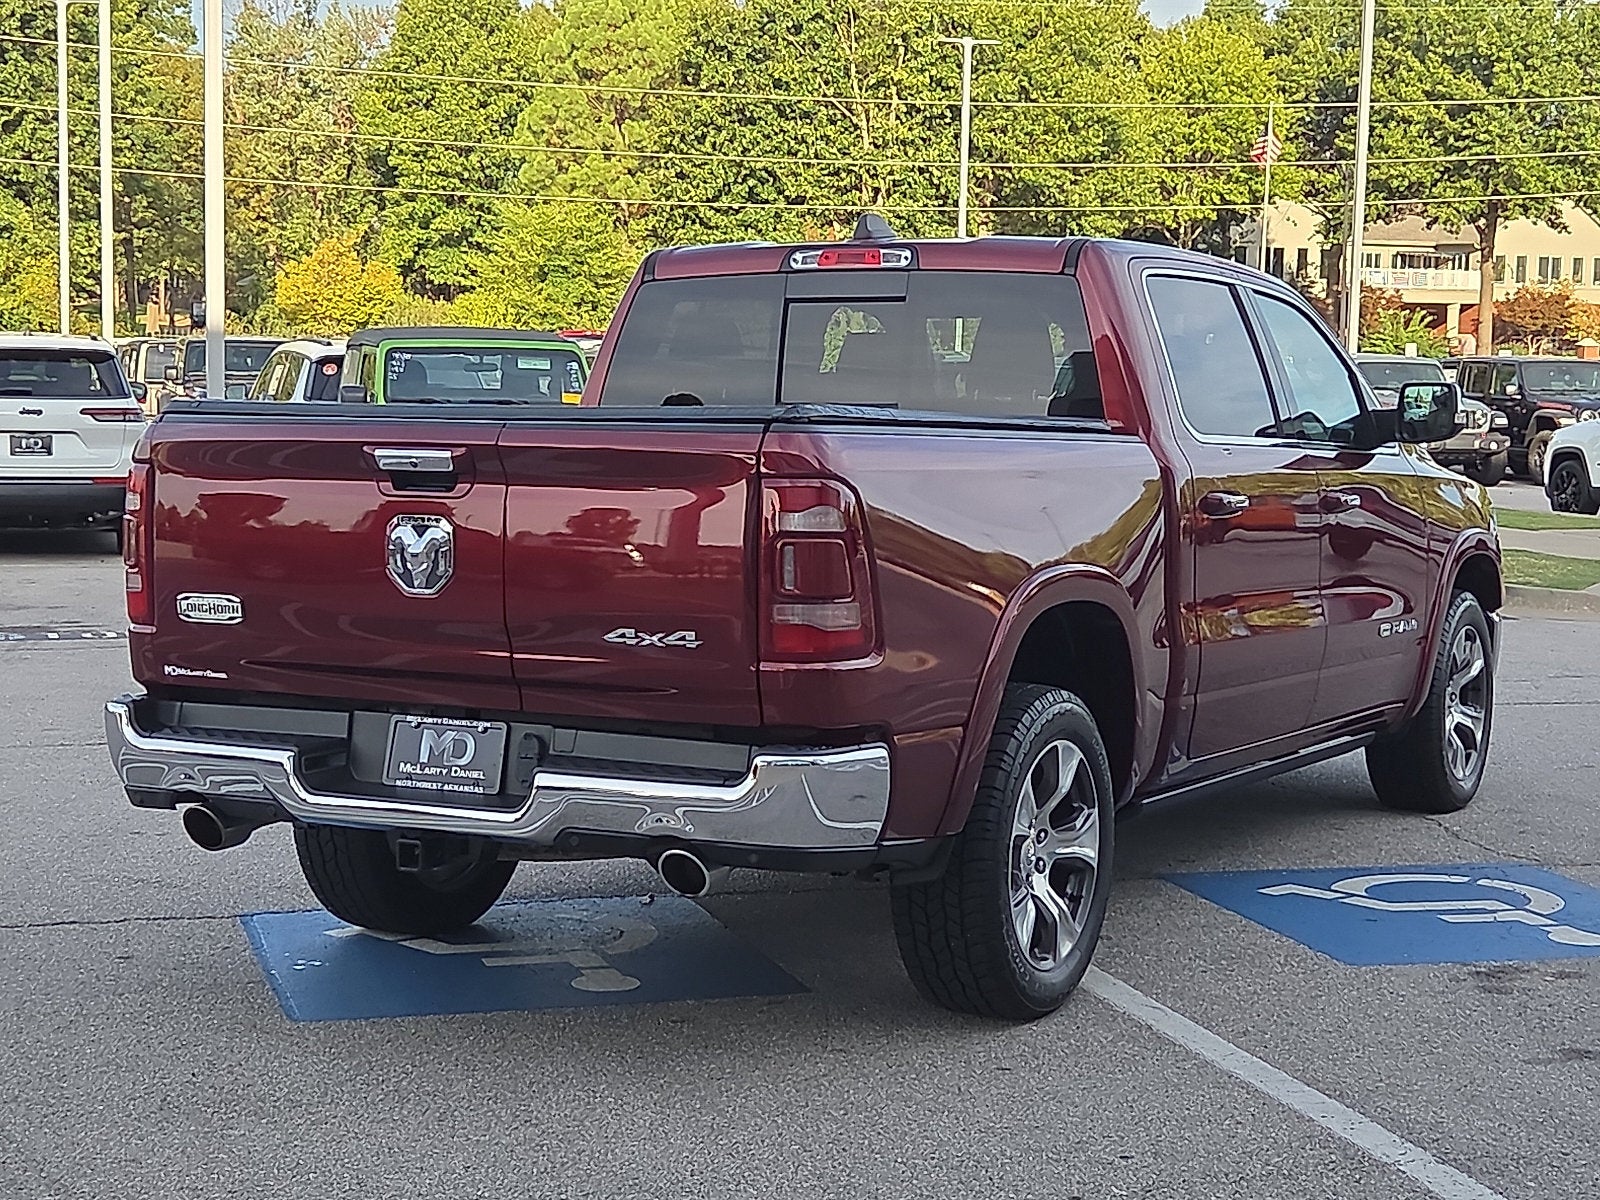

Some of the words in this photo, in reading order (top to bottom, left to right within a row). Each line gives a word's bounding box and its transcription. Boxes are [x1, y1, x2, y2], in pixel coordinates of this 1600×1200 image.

[602, 627, 703, 648] 4x4
[420, 728, 476, 766] MD
[450, 766, 486, 779] DANIEL
